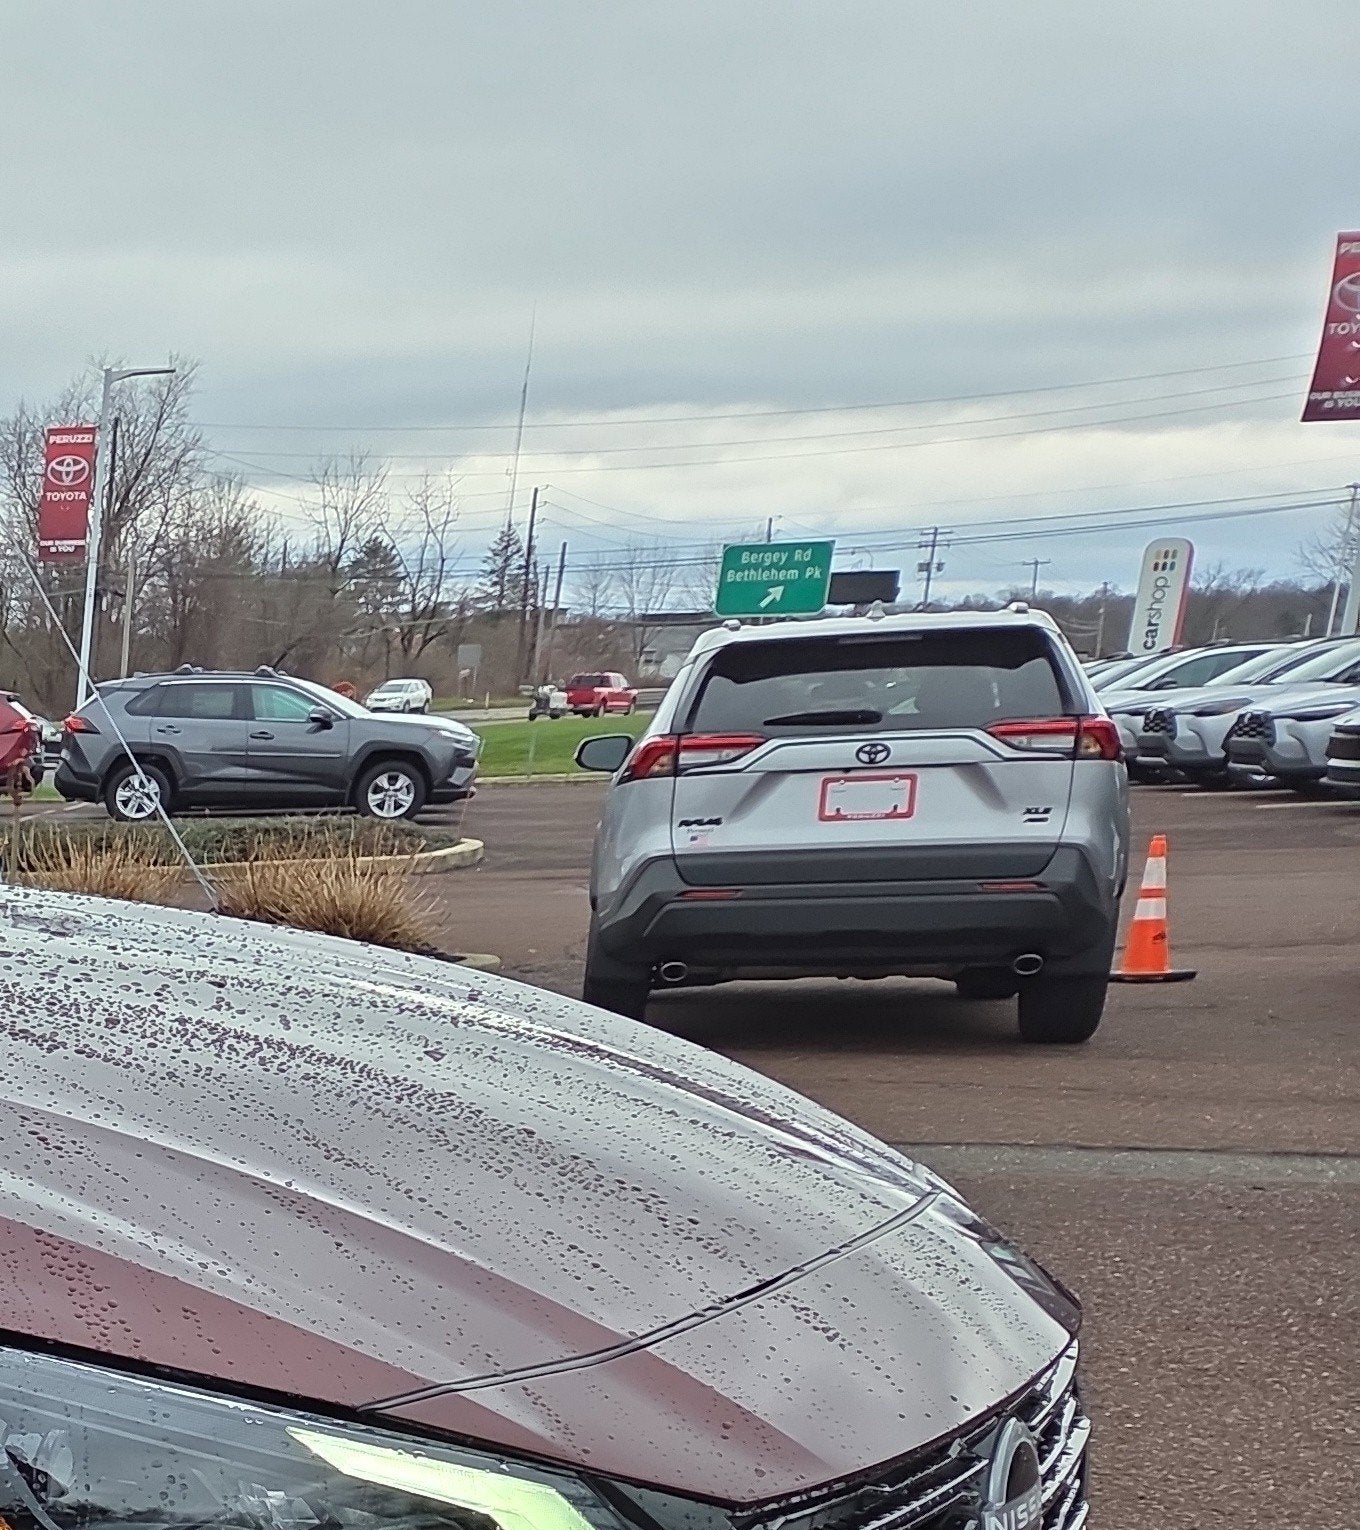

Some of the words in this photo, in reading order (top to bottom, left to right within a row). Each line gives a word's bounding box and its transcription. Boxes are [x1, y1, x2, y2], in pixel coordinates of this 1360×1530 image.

[1328, 322, 1360, 335] TOY
[49, 433, 93, 445] PERUZZI
[45, 491, 88, 502] TOYOTA
[741, 550, 789, 567] Bergey
[794, 548, 813, 562] Rd
[726, 567, 799, 583] Bethlehem
[805, 566, 823, 579] Pk
[1142, 576, 1171, 650] carshop
